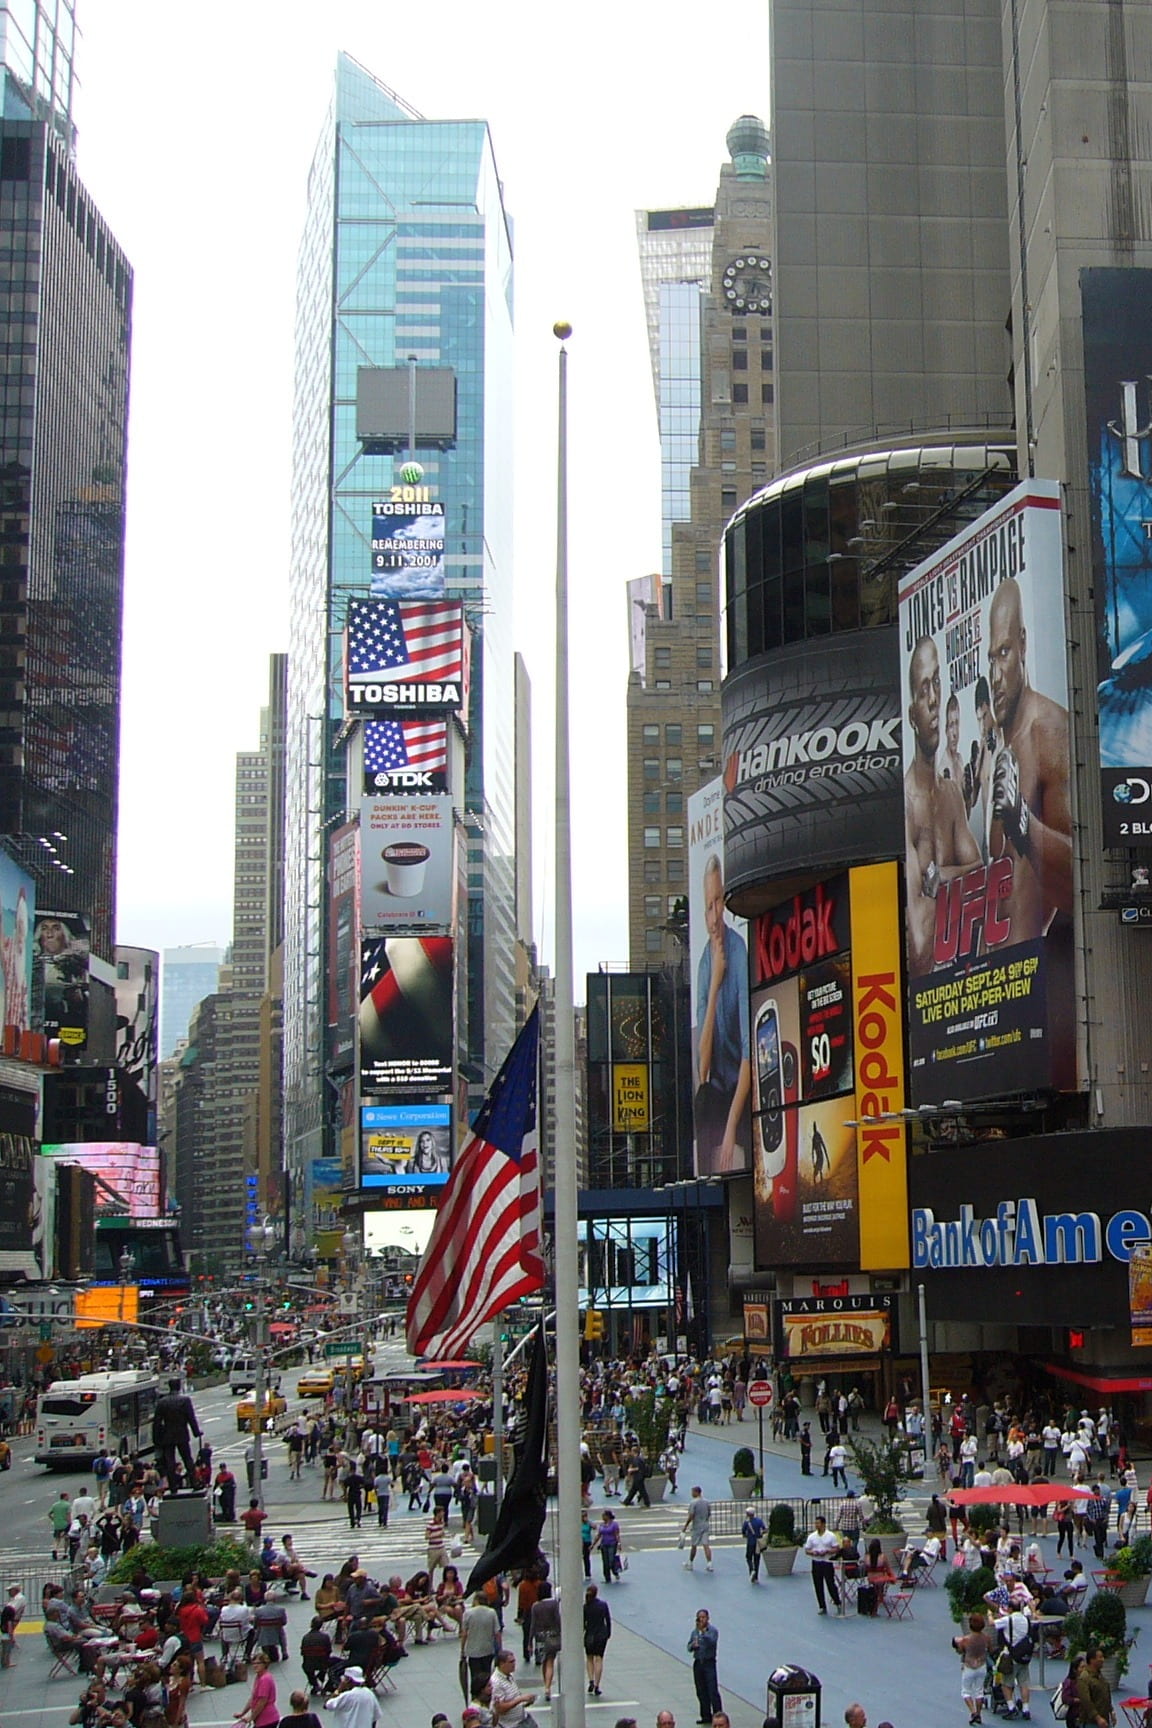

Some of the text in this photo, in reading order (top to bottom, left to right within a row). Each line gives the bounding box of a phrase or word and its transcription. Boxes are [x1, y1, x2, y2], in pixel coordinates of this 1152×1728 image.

[390, 486, 429, 502] 2011
[373, 504, 443, 515] TOSHIBA
[372, 540, 444, 550] REMEMBERING
[376, 555, 437, 567] 9.11.2001
[906, 574, 944, 652] JONES
[960, 512, 1026, 614] RAMPAGE
[349, 684, 460, 703] TOSHIBA
[387, 772, 433, 786] TDK
[754, 754, 899, 794] driving emotion
[1120, 823, 1129, 835] 2
[934, 857, 1014, 964] UFC
[755, 883, 838, 982] Kodak
[915, 980, 964, 1009] SATURDAY
[922, 978, 1032, 1024] LIVE ON PAY-PER-VIEW
[858, 971, 900, 1165] Kodak
[621, 1077, 640, 1086] THE
[106, 1068, 117, 1114] 1500
[617, 1089, 644, 1105] LION
[399, 1111, 447, 1121] Corporation
[617, 1107, 645, 1122] KING
[387, 1185, 425, 1194] SONY
[781, 1296, 891, 1312] MARQUIS
[800, 1322, 874, 1354] FOLLIES
